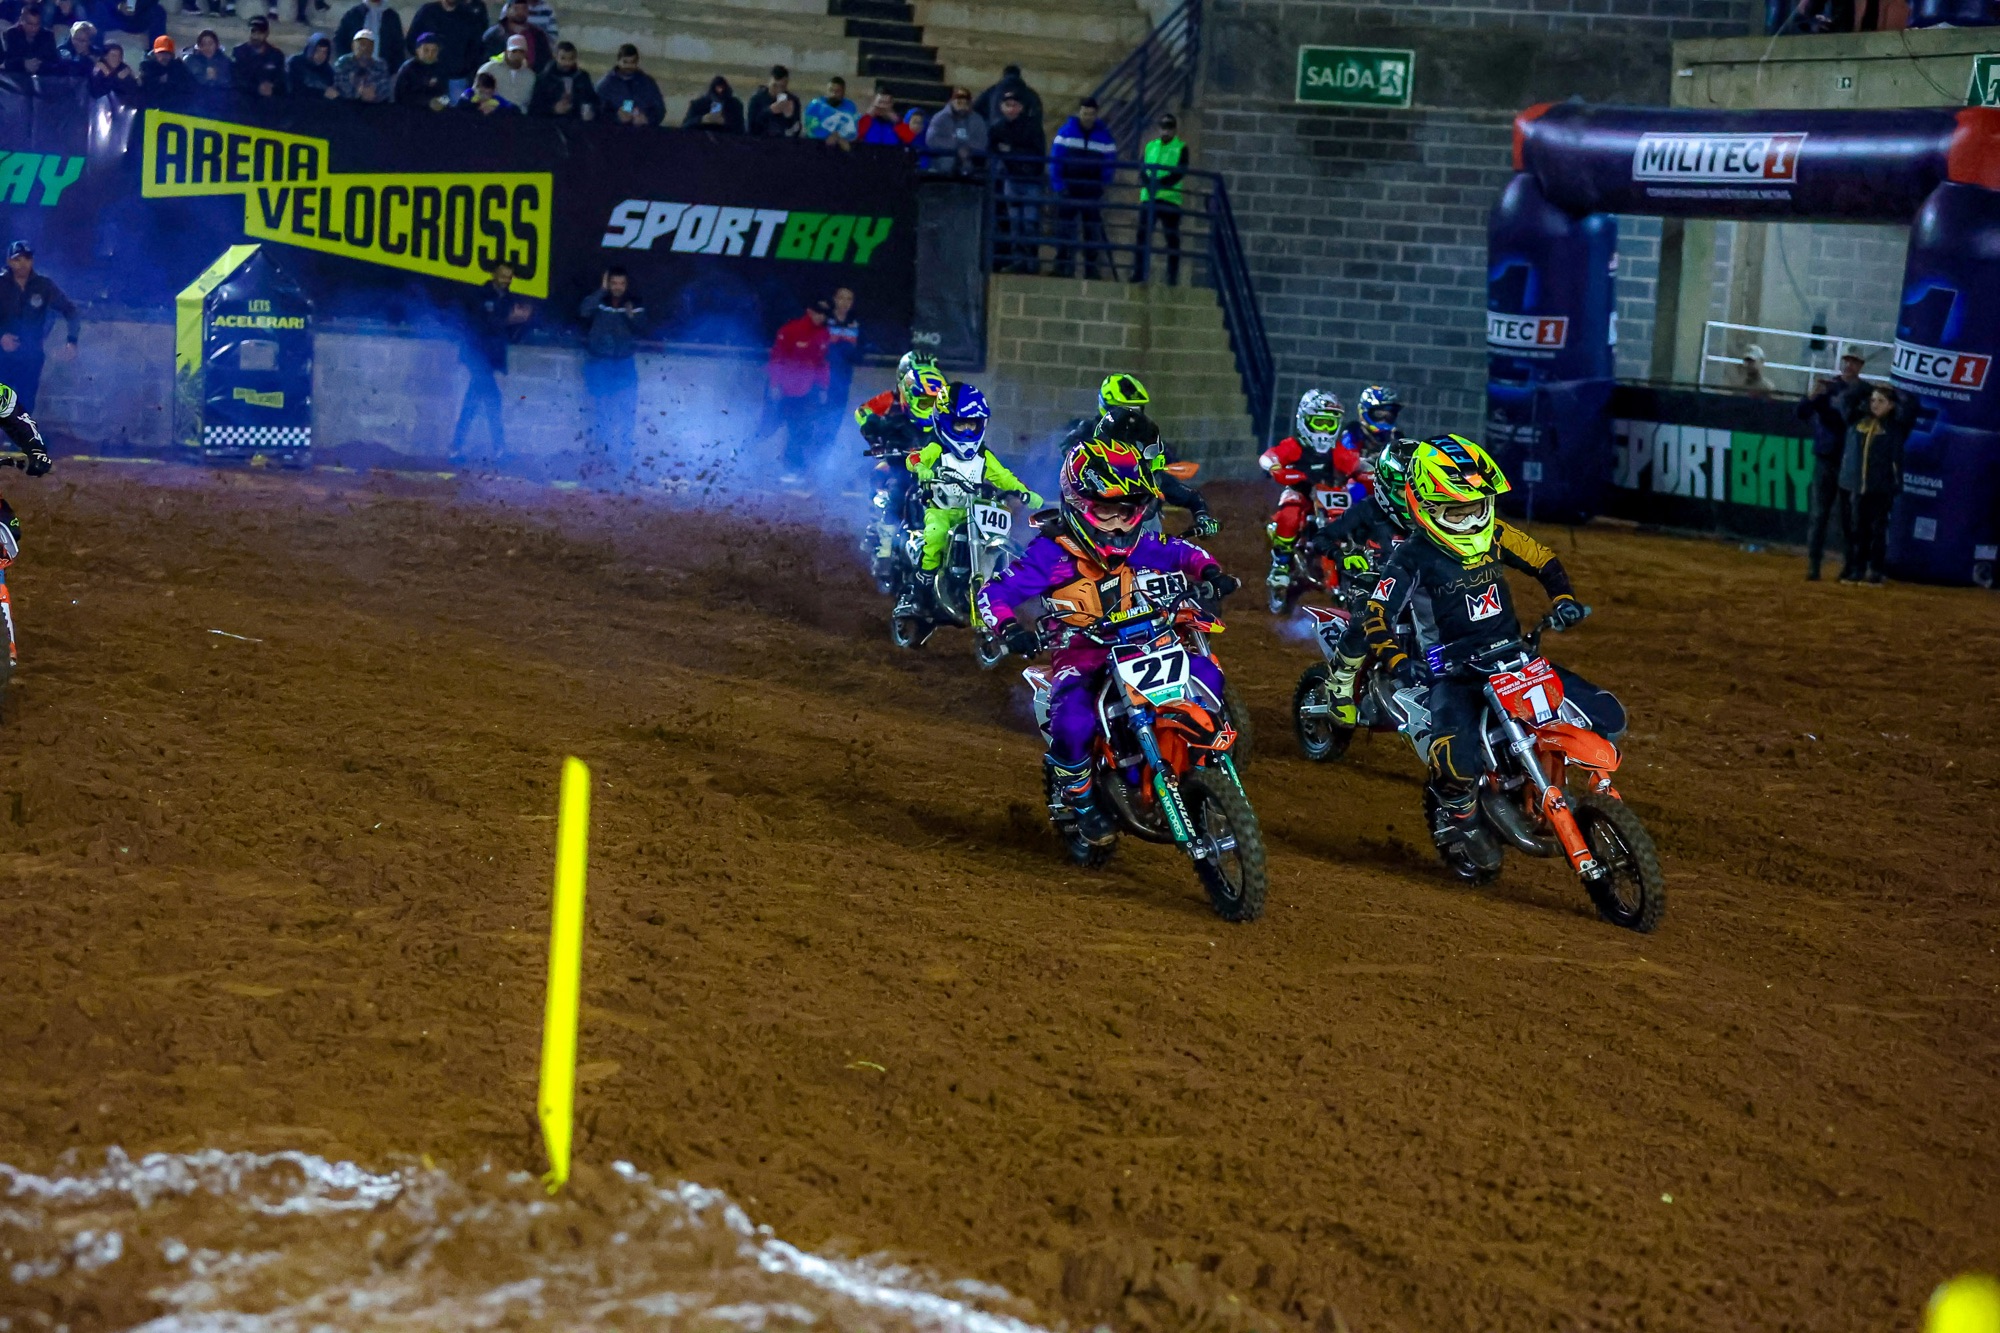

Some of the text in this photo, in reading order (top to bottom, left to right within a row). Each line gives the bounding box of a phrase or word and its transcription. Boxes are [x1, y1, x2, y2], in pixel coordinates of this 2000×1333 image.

[1305, 62, 1375, 89] SAÍDA
[155, 122, 319, 185] ARENA
[1642, 141, 1765, 173] MILITEC
[0, 150, 85, 206] AY
[257, 183, 540, 281] VELOCROSS
[601, 199, 893, 265] SPORTBAY
[1431, 439, 1474, 464] FOX
[1612, 418, 1816, 513] SPORTBAY
[980, 509, 1007, 530] 140
[1325, 493, 1348, 507] 13
[1132, 650, 1184, 691] 27
[1522, 684, 1553, 724] 1
[1160, 796, 1184, 838] MOTOREX
